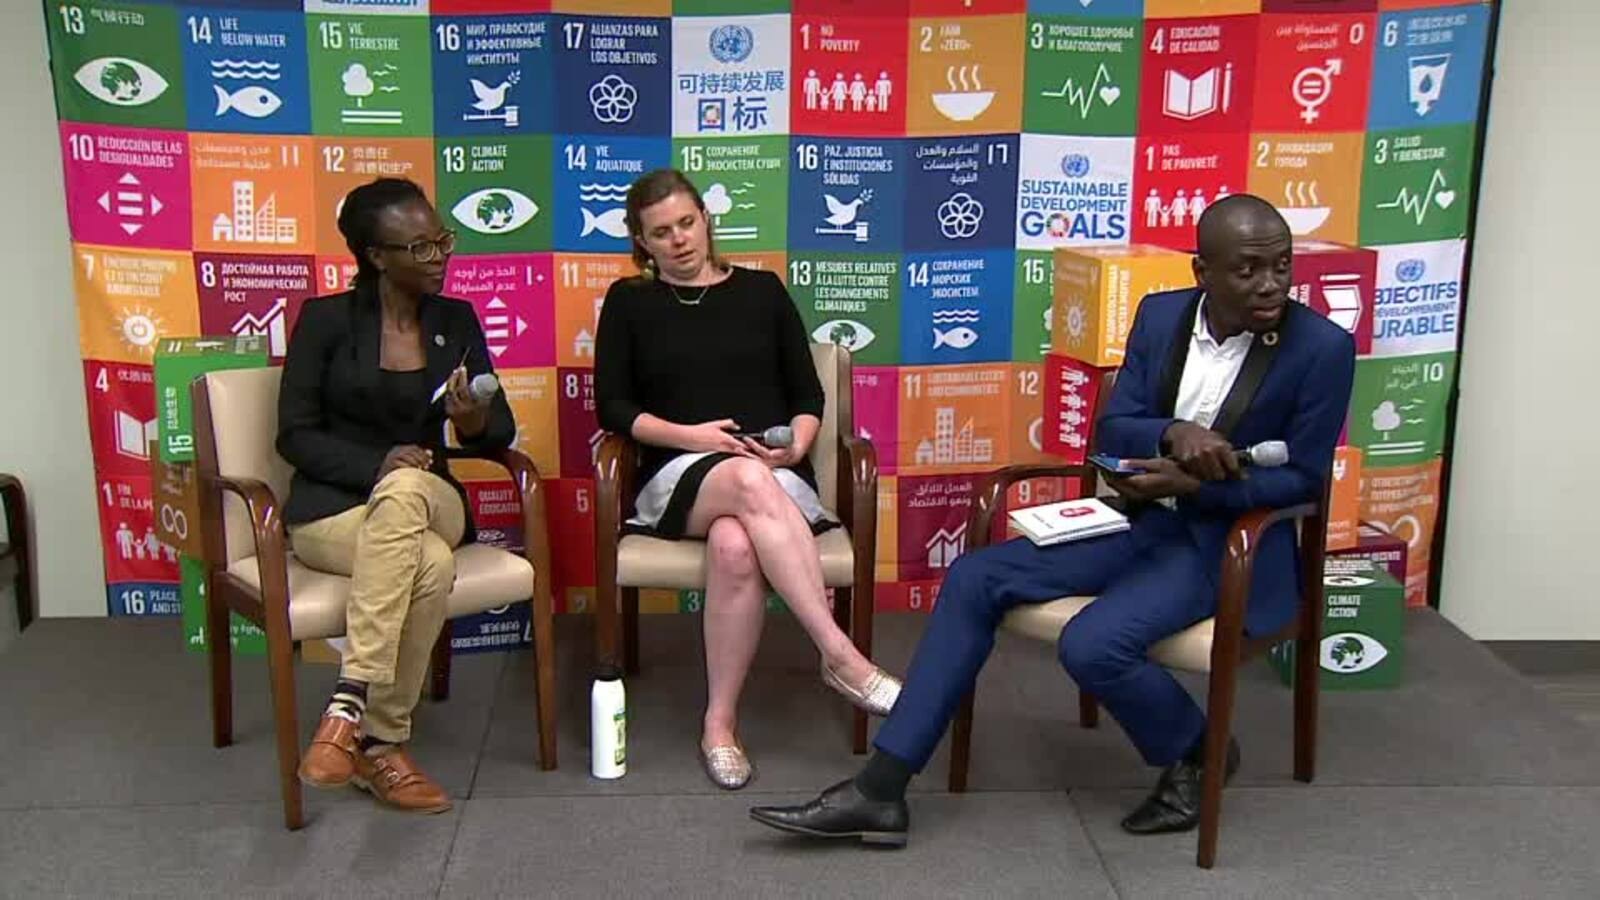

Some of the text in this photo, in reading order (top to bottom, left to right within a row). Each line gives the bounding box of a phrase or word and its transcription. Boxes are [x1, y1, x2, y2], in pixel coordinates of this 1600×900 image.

[59, 6, 85, 35] 13
[220, 18, 239, 30] LIFE
[348, 23, 363, 34] VIE
[466, 22, 545, 35] МИР, ПРАВОСУДИЕ
[187, 16, 213, 44] 14
[320, 22, 342, 49] 15
[436, 24, 459, 50] 16
[563, 23, 584, 49] 17
[591, 23, 659, 37] ALIANZAS PARA
[800, 23, 811, 50] 1
[821, 25, 834, 36] NO
[1031, 22, 1044, 49] 3
[1090, 26, 1134, 39] ЗДОРОВЬЕ
[1170, 24, 1220, 37] EDUCACIÓN
[1384, 21, 1398, 47] 6
[222, 33, 285, 47] BELOW WATER
[350, 38, 400, 49] TERRESTRE
[467, 37, 541, 49] И ЭФФЕКТИВНЫЕ
[591, 38, 625, 50] LOGRAR
[821, 39, 860, 52] POVERTY
[920, 26, 932, 52] 2
[1150, 28, 1164, 54] 4
[1170, 40, 1220, 54] DE CALIDAD
[467, 53, 519, 65] ИНСТИТУТЫ
[591, 51, 658, 64] LOS OBJETIVOS
[678, 71, 785, 93] 可持续发展
[698, 96, 767, 132] 目标
[69, 134, 94, 161] 10
[98, 136, 151, 152] REDUCCIÓN
[152, 140, 164, 153] DE
[164, 141, 183, 154] LAS
[595, 145, 609, 157] VIE
[706, 145, 760, 157] СОХРАНЕНИЕ
[843, 145, 883, 157] JUSTICIA
[1163, 145, 1180, 156] PAS
[1393, 136, 1421, 149] SALUD
[323, 146, 345, 173] 12
[442, 146, 465, 173] 13
[471, 145, 507, 158] CLIMATE
[564, 144, 587, 171] 14
[681, 146, 702, 172] 15
[797, 144, 818, 170] 16
[1145, 146, 1155, 171] 1
[1256, 142, 1269, 167] 2
[1374, 139, 1388, 164] 3
[1400, 147, 1446, 162] BIENESTAR
[100, 153, 174, 168] DESIGUALDADES
[472, 159, 504, 172] ACTION
[595, 160, 643, 173] AQUATIQUE
[706, 157, 781, 171] ЭКОСИСТЕМ СУШИ
[824, 159, 893, 172] E INSTITUCIONES
[1162, 156, 1219, 171] DE PAUVRETÉ
[823, 172, 860, 186] SÓLIDAS
[1021, 179, 1128, 197] SUSTAINABLE
[1021, 196, 1127, 212] DEVELOPMENT
[1020, 211, 1125, 240] GOALS
[82, 254, 94, 280] 7
[221, 262, 309, 276] ДОСТОЙНАЯ РАБОТА
[790, 261, 811, 286] 13
[816, 261, 896, 273] MESURES RELATIVES
[933, 259, 984, 271] СОХРАНЕНИЕ
[1023, 259, 1044, 284] 15
[201, 262, 216, 287] 8
[324, 265, 338, 288] 9
[561, 262, 580, 287] 11
[824, 275, 832, 285] LA
[833, 275, 857, 285] LUTTE
[858, 275, 888, 285] CONTRE
[908, 263, 928, 287] 14
[931, 274, 971, 285] МОРСКИХ
[223, 277, 308, 290] И ЭКОНОМИЧЕСКИЙ
[224, 291, 247, 302] РОСТ
[815, 288, 889, 300] LES CHANGEMENTS
[932, 287, 979, 299] ЭКОСИСТЕМ
[1373, 281, 1458, 305] BJECTIFS
[815, 300, 867, 312] CLIMATIQUES
[1373, 313, 1455, 339] URABLE
[95, 368, 109, 392] 4
[566, 374, 578, 398] 8
[905, 374, 921, 398] 11
[1018, 371, 1039, 395] 12
[168, 434, 194, 454] 15
[103, 482, 113, 506] 1
[479, 490, 513, 501] QUALITY
[576, 489, 588, 512] 5
[1018, 483, 1030, 504] 9
[121, 590, 145, 614] 16
[688, 592, 700, 612] 3
[910, 587, 920, 608] 5
[1328, 595, 1360, 605] CLIMATE
[152, 603, 170, 614] AND
[1328, 607, 1358, 617] ACTION
